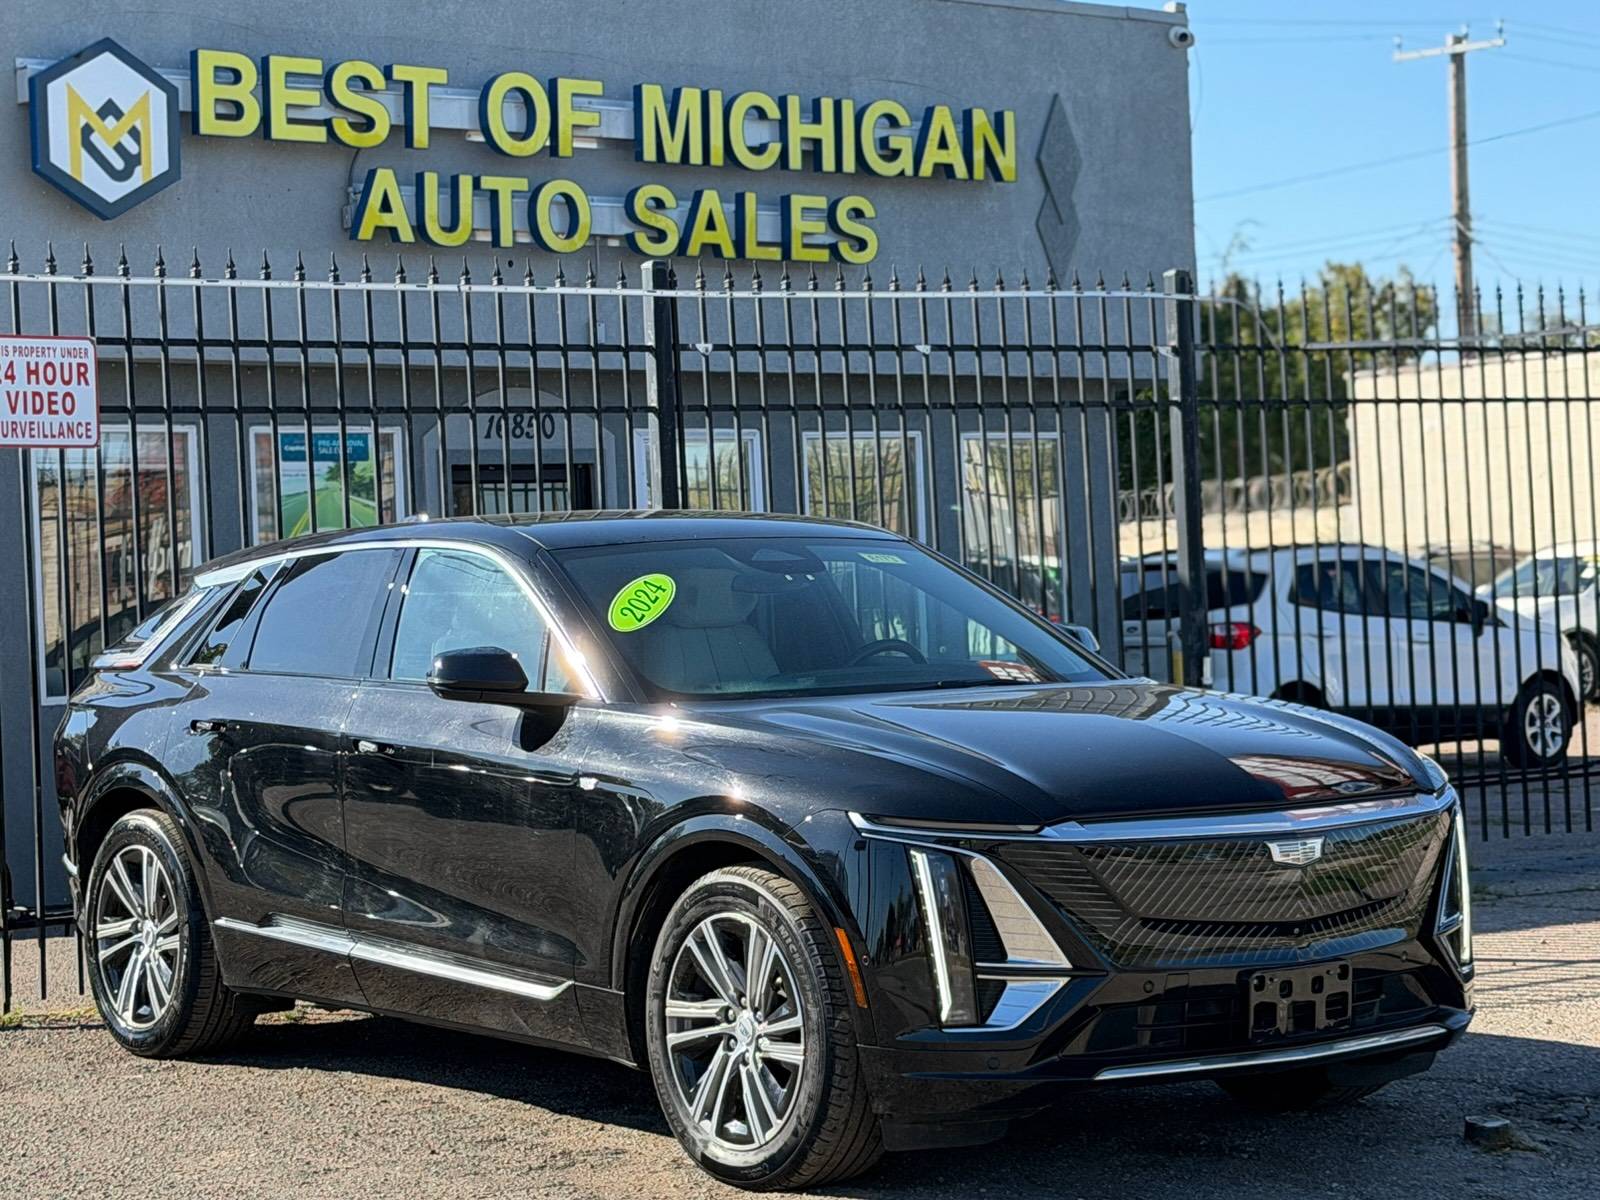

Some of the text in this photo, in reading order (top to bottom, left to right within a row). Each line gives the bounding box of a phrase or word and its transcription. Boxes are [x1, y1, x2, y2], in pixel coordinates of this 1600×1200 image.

[191, 47, 1017, 183] BEST OF MICHIGAN
[350, 167, 878, 265] AUTO SALES
[12, 346, 58, 358] PROPERTY
[60, 348, 89, 359] UNDER
[0, 360, 90, 386] 4 HOUR
[6, 390, 76, 416] VIDEO
[620, 580, 667, 623] 2024
